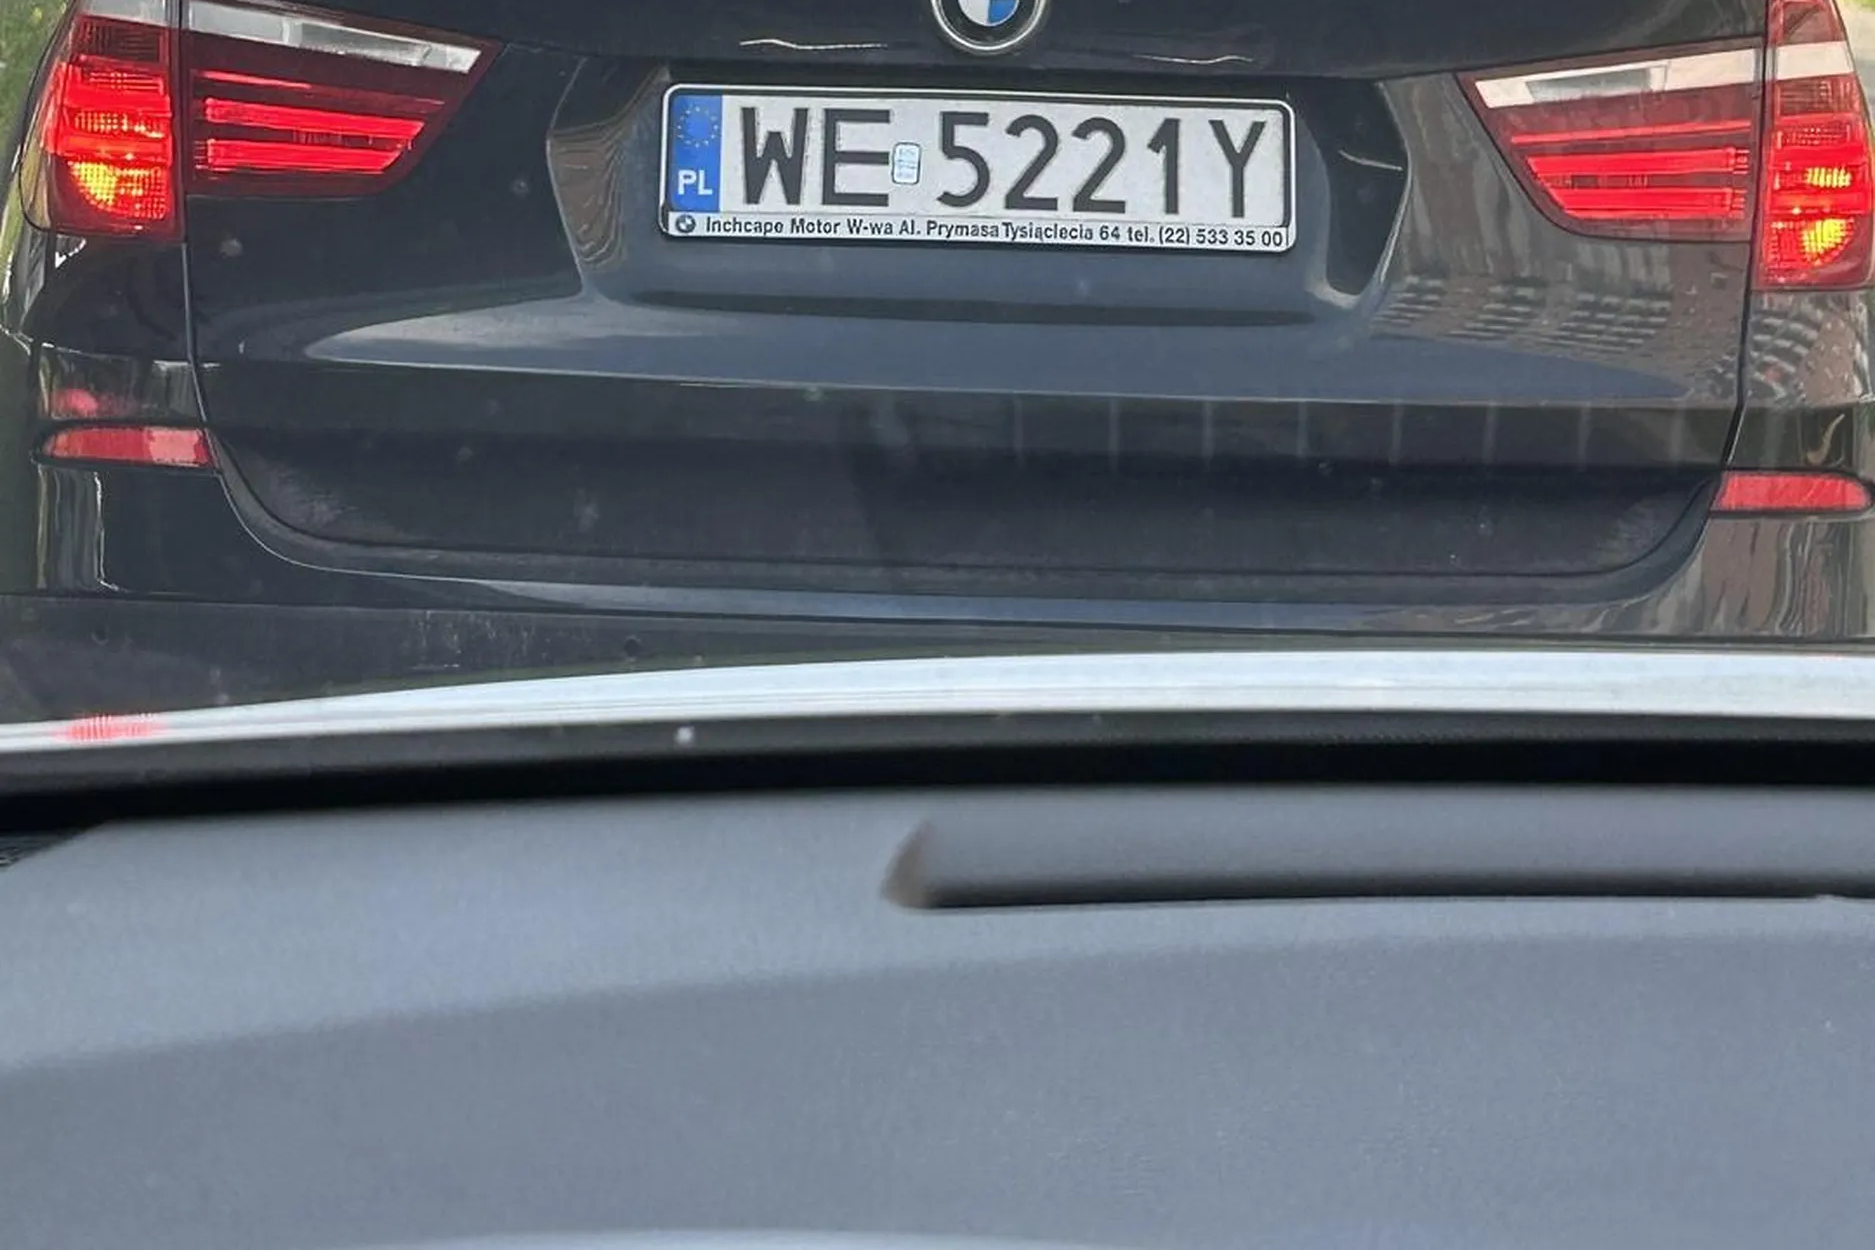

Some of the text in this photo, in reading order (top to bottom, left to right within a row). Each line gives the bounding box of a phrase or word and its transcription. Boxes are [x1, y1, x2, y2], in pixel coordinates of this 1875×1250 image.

[741, 107, 1267, 218] WE 52221Y
[677, 169, 713, 196] PL
[706, 216, 1283, 246] Inchcape Motor W-wa Al. Prymasa Tysiąclecia 64 tel. (22) 533 35 00
